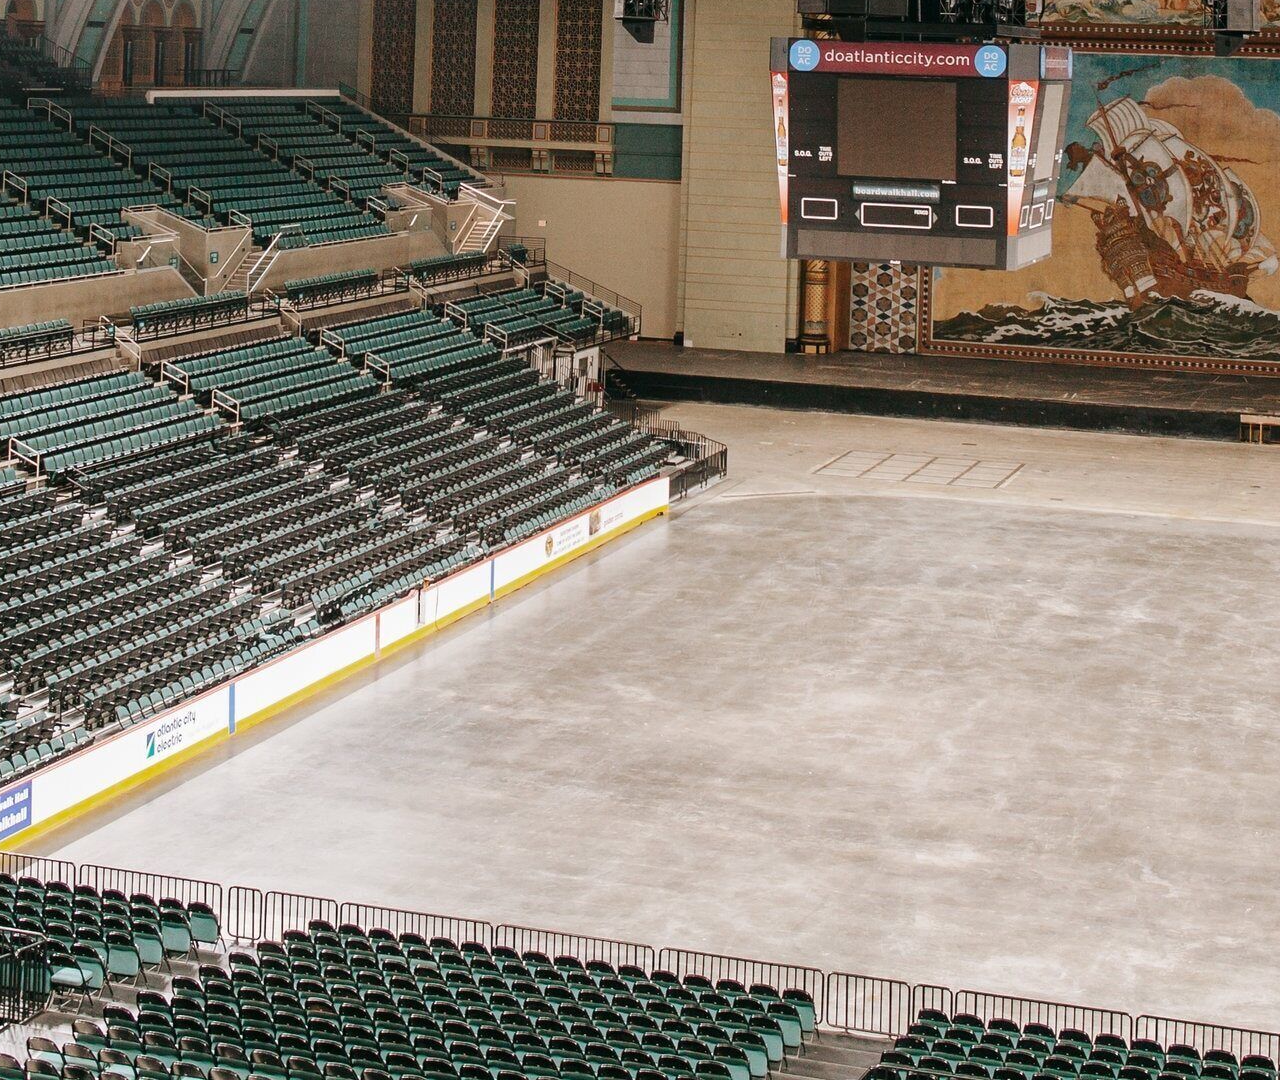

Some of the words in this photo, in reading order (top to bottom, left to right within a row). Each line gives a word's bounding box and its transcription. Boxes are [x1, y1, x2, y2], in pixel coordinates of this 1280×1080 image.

[797, 46, 812, 54] DO
[824, 49, 970, 67] doatlanticcity.com
[855, 186, 938, 198] boardwalkhall.com
[157, 717, 182, 738] atlantic
[183, 711, 196, 725] city
[157, 732, 182, 753] electric
[15, 788, 29, 804] Hall
